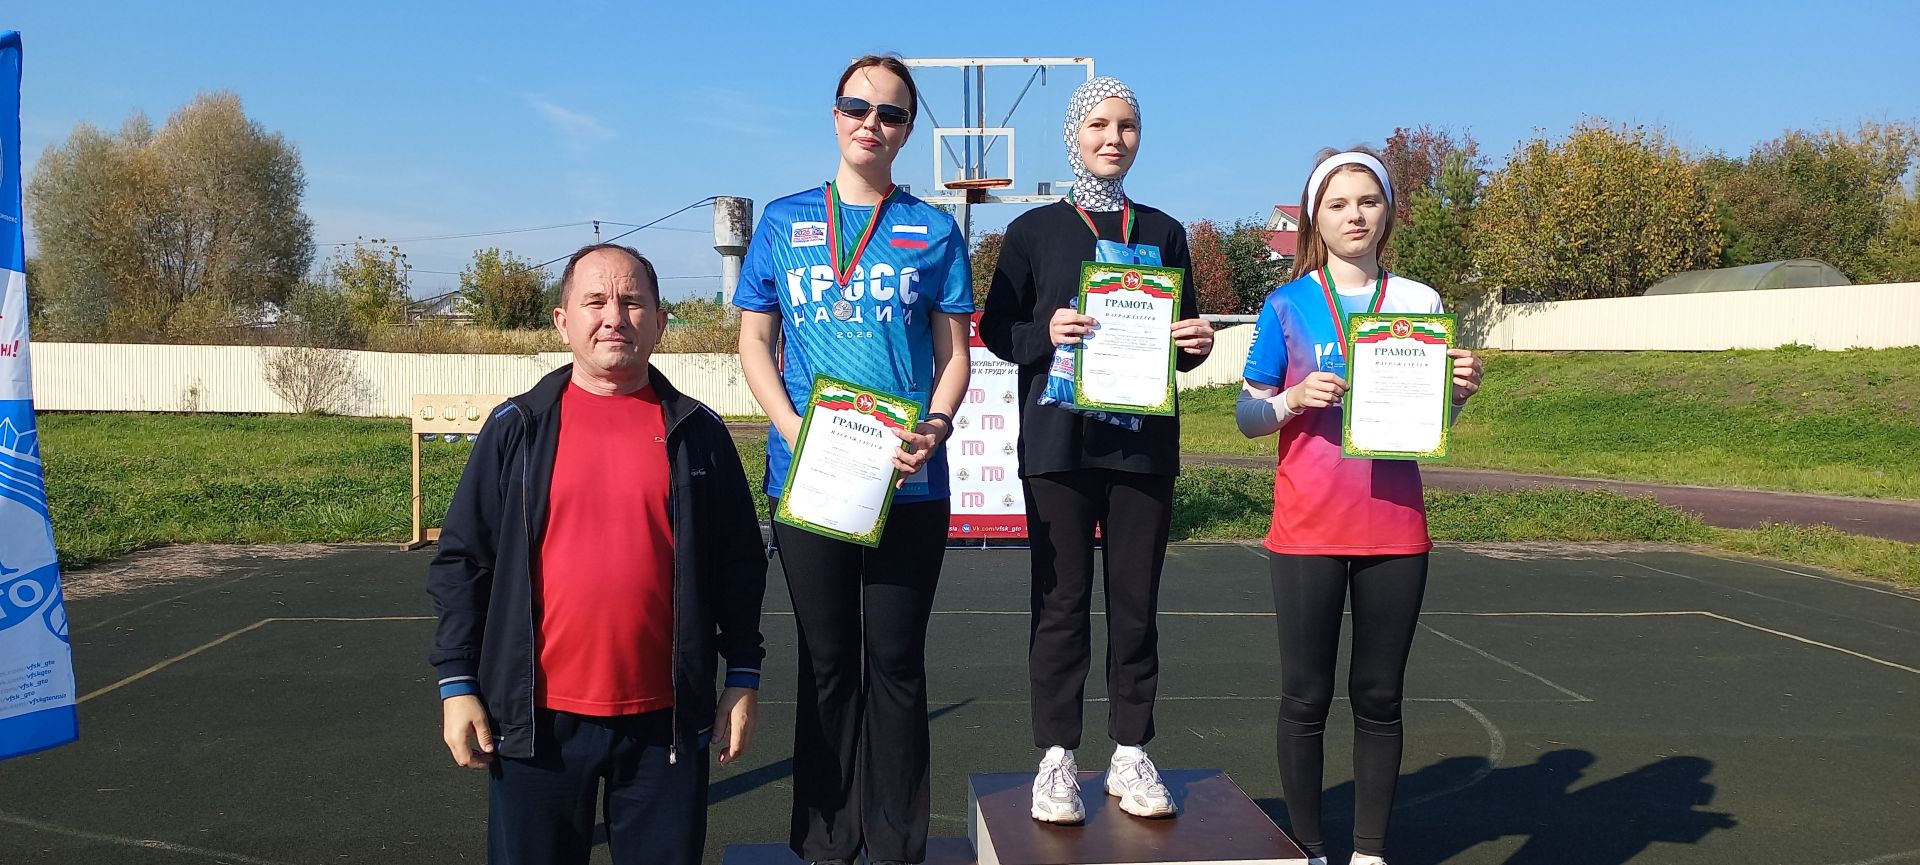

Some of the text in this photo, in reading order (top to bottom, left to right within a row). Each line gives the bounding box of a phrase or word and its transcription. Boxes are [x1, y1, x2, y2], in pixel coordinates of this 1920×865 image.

[786, 262, 921, 307] КРОСС
[1105, 298, 1154, 310] ГРАМОТА
[1374, 347, 1426, 357] ГРАМОТА
[985, 368, 1007, 376] ТРУДУ
[832, 415, 883, 438] ГРАМОТА
[981, 414, 1005, 430] ГТО
[961, 440, 985, 456] ГТО
[981, 466, 1005, 481] ГТО
[961, 492, 985, 507] ГТО
